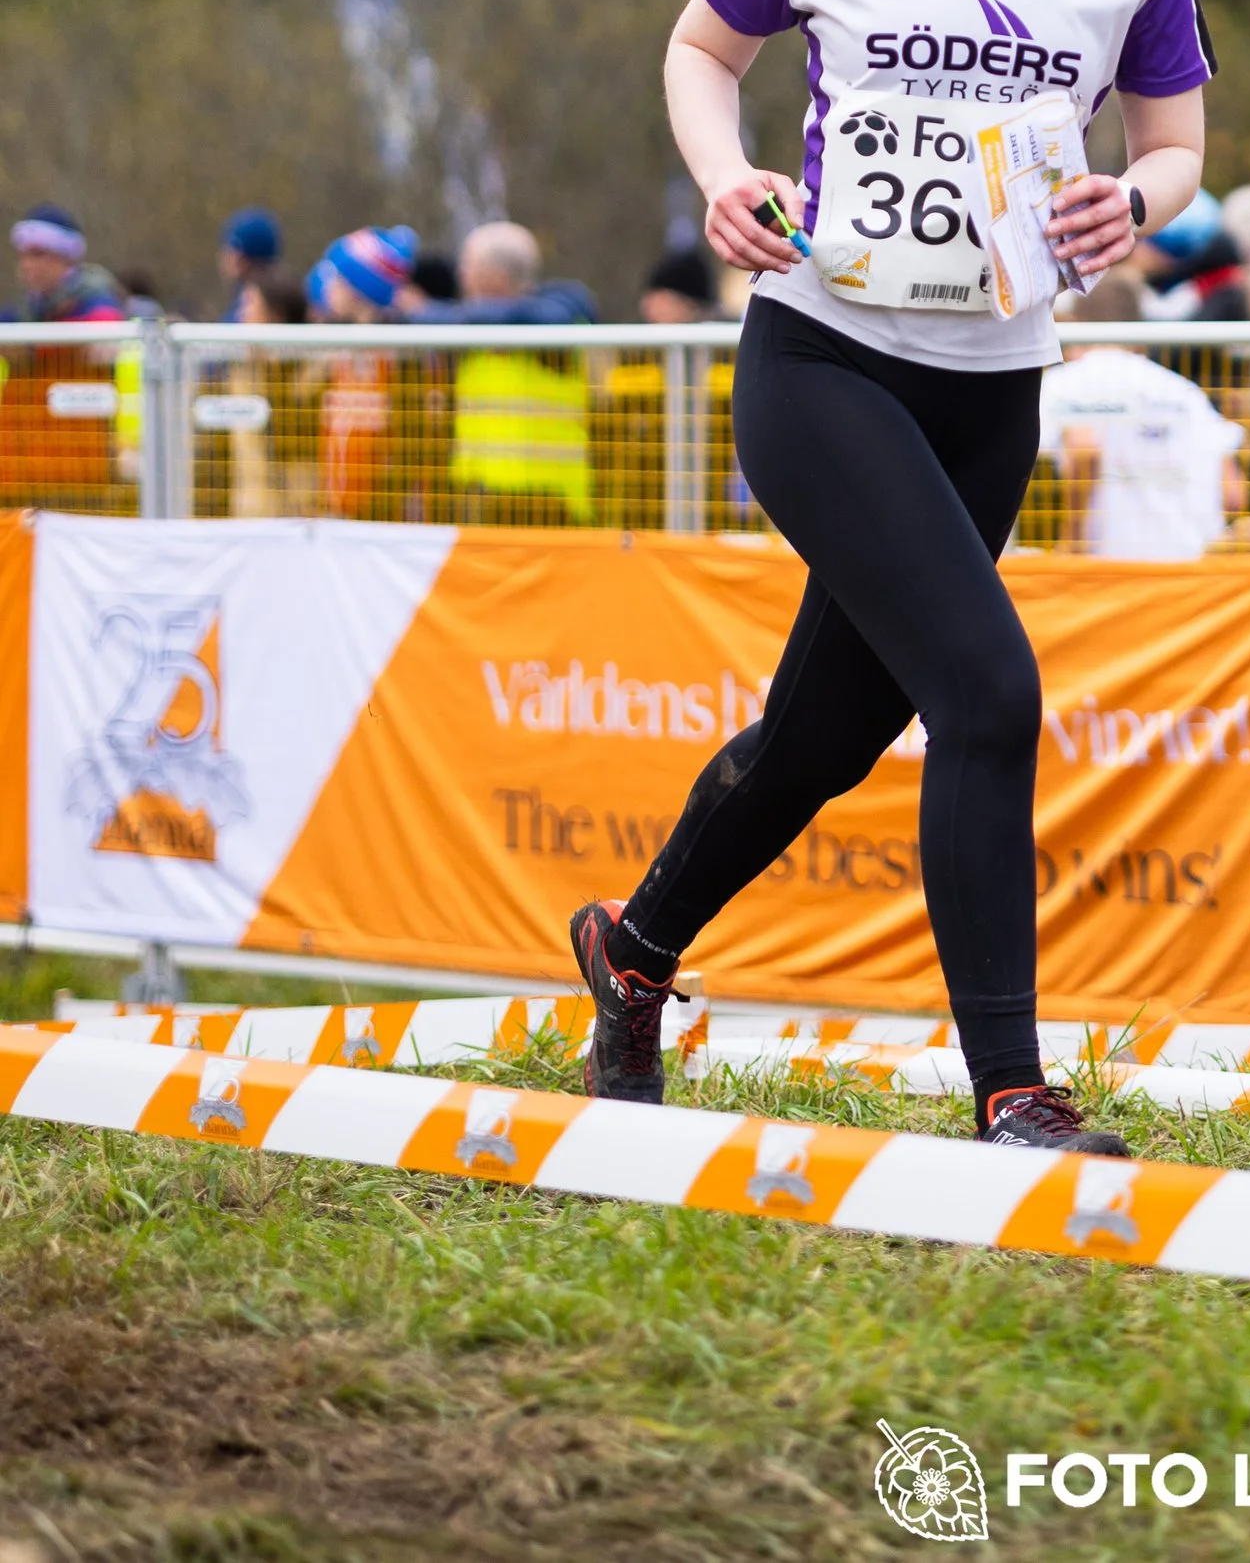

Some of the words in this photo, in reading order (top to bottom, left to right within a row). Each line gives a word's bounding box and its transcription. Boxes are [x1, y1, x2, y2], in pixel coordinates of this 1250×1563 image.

[866, 24, 1082, 88] SÖDERS
[913, 115, 976, 164] Fo
[851, 171, 984, 250] 36
[492, 785, 595, 861] The
